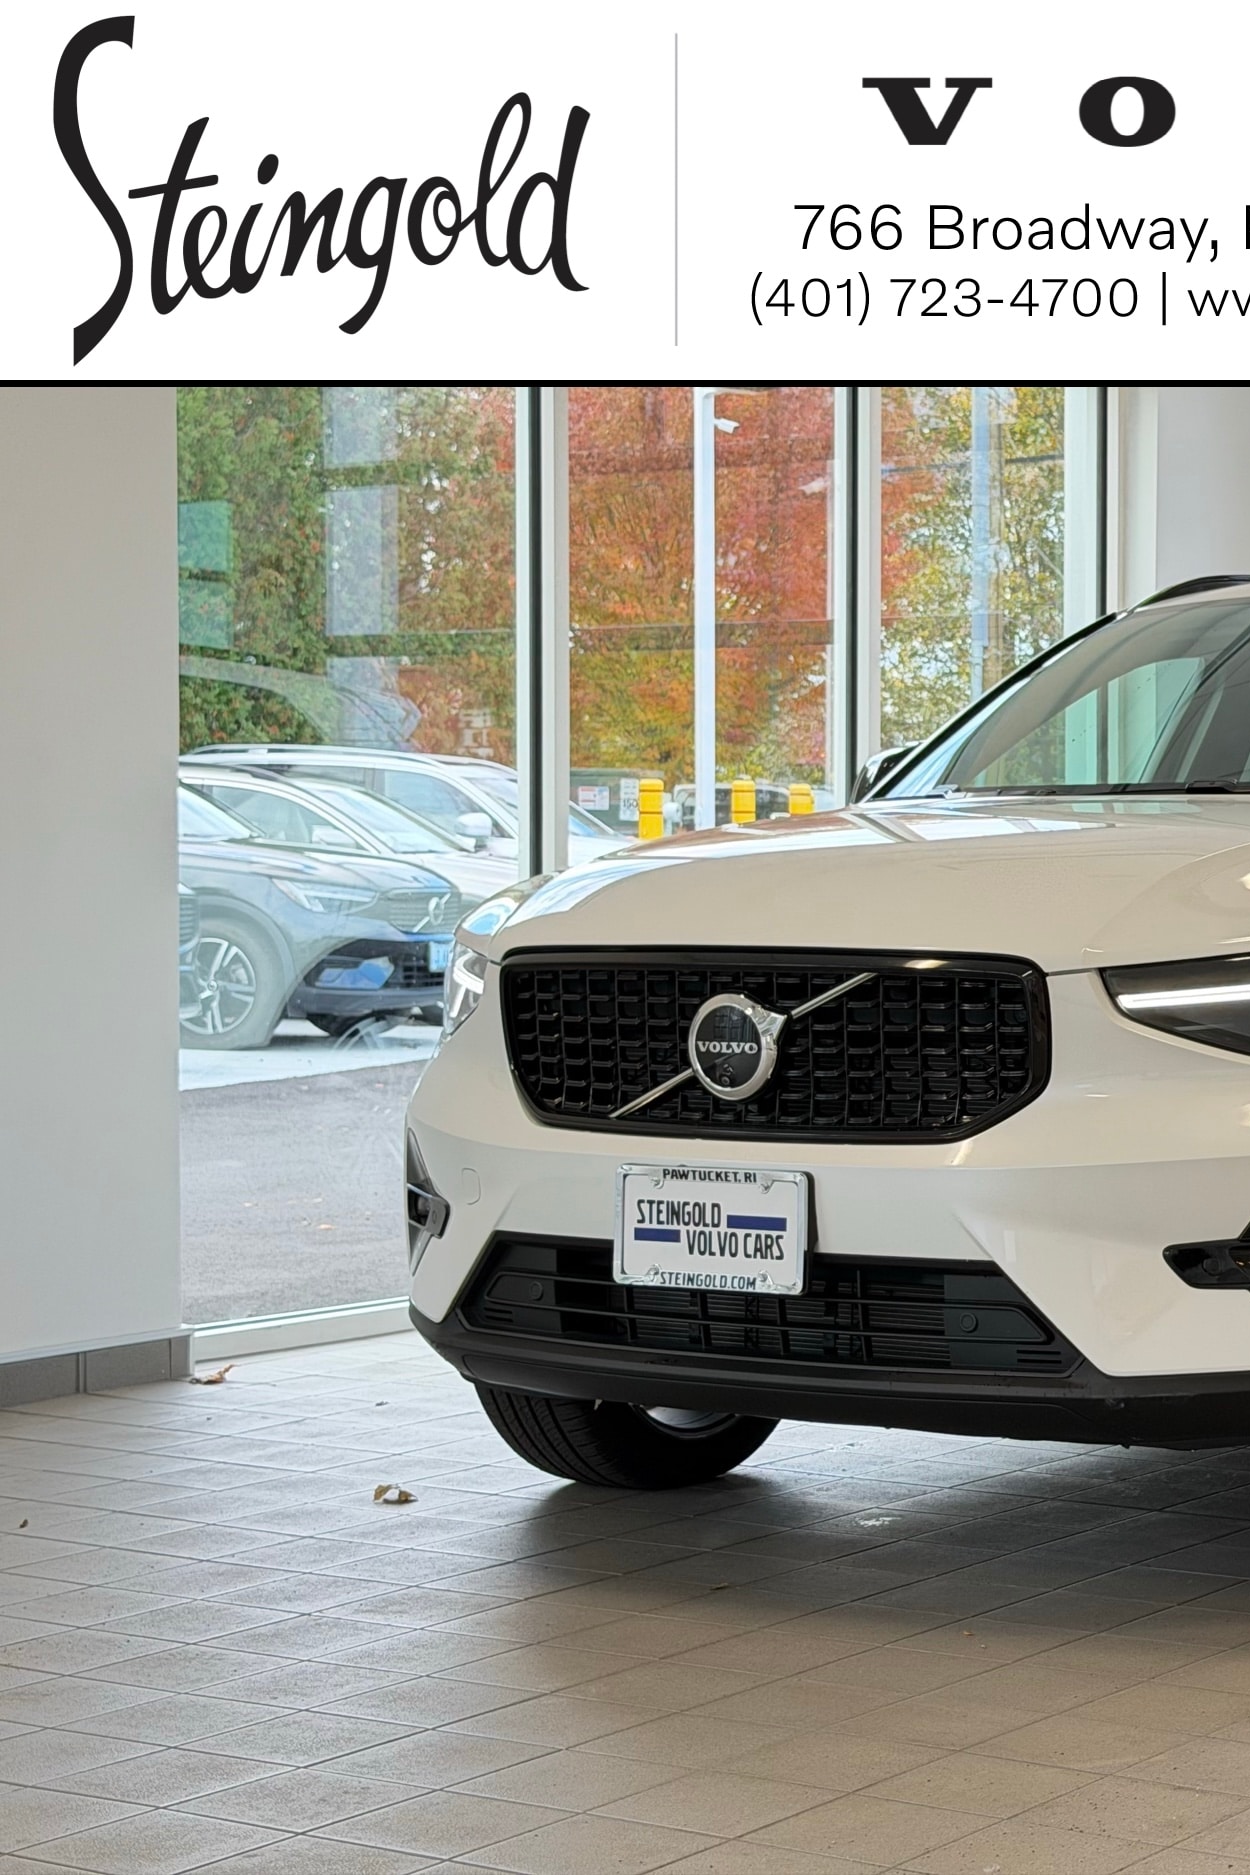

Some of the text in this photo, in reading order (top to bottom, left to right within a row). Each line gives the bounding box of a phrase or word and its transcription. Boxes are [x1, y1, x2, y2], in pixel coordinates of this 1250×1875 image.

[697, 1041, 759, 1054] VOLVO
[744, 1172, 757, 1184] RI
[636, 1199, 722, 1228] STEINGOLD
[686, 1229, 785, 1261] VOLVO CARS
[659, 1271, 757, 1290] STEINGOLD.COM
